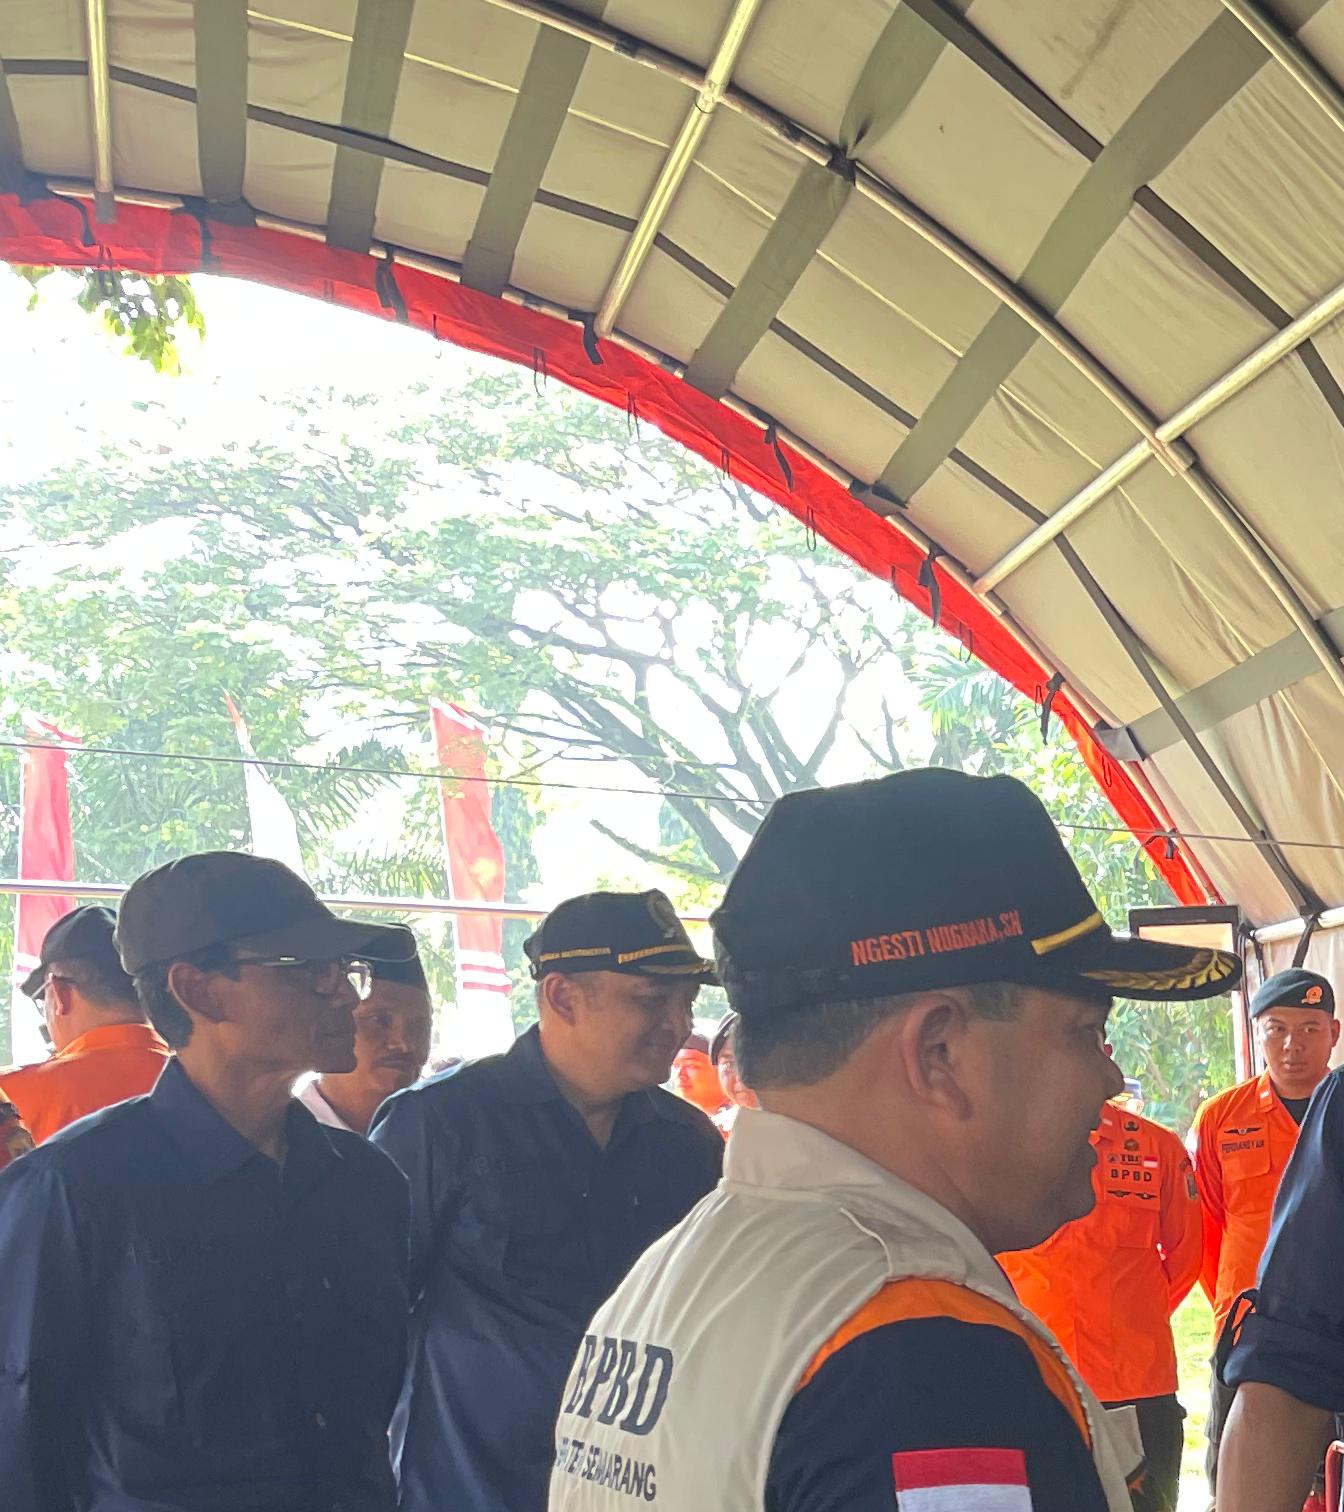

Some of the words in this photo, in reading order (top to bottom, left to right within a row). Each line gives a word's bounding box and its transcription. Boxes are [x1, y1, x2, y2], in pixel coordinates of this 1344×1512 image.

[851, 930, 925, 966] NGESTI
[1111, 1169, 1152, 1182] BPBD
[564, 1335, 673, 1436] BPBD
